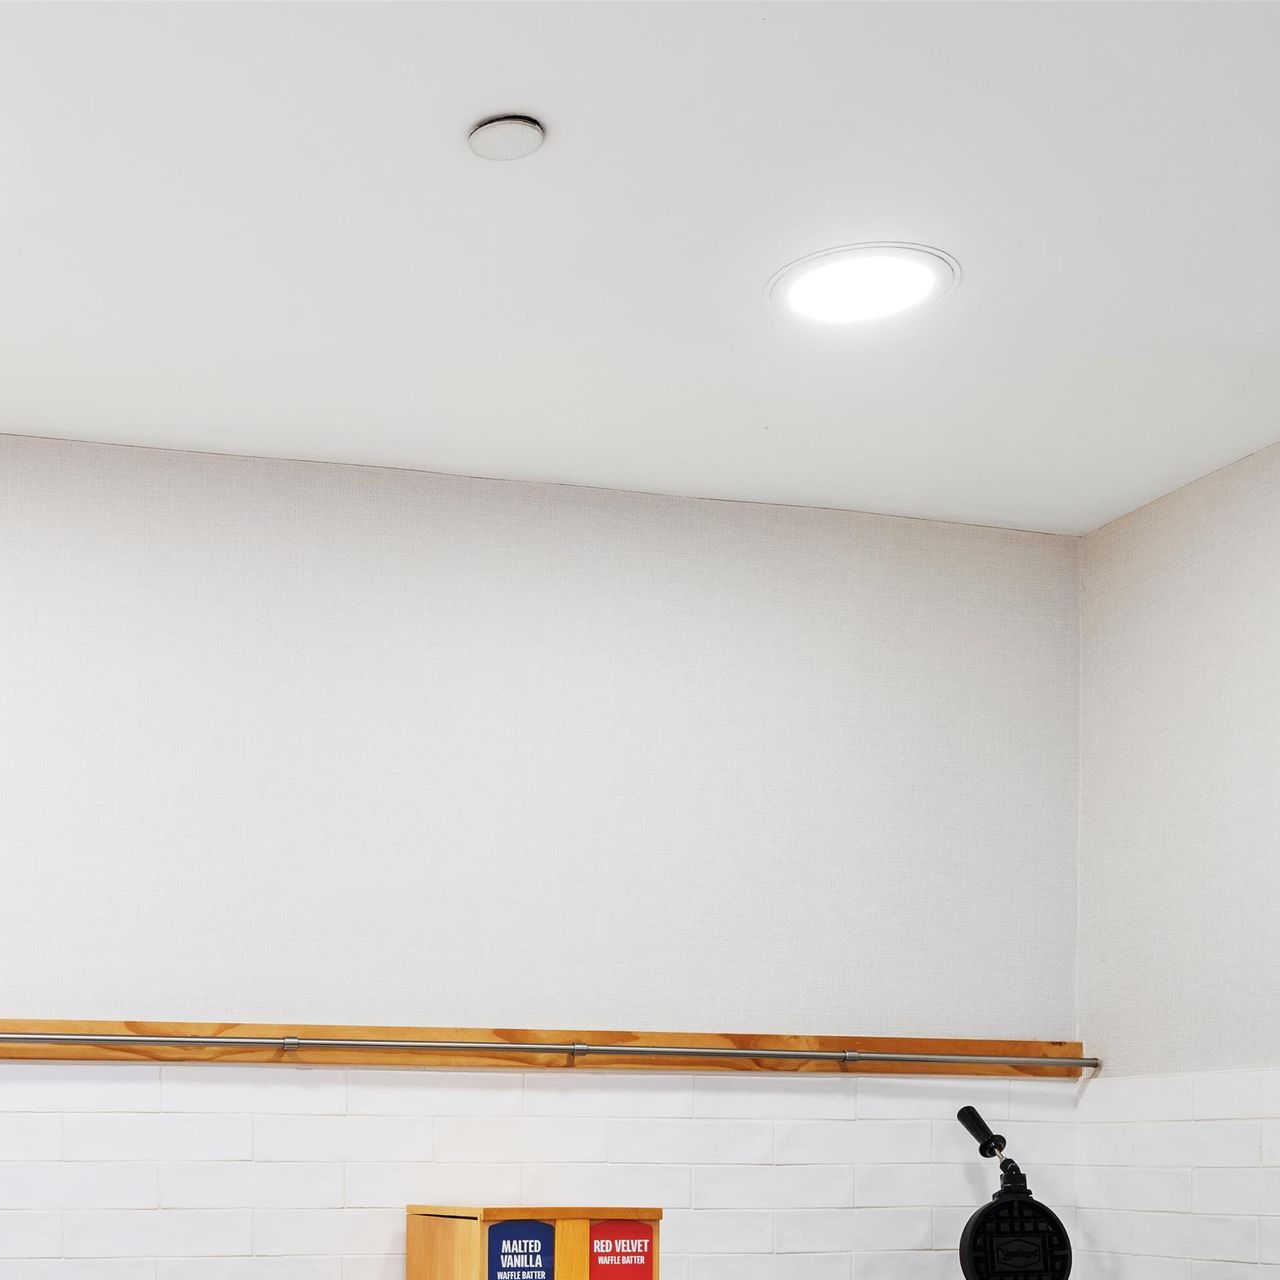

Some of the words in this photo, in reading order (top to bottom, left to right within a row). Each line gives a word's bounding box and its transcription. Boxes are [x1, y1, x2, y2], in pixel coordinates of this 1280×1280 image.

[501, 1240, 542, 1253] MALTED
[593, 1240, 612, 1253] RED
[614, 1240, 650, 1253] VELVET
[500, 1254, 543, 1268] VANILLA
[597, 1256, 621, 1265] WAFFLE
[621, 1256, 645, 1265] BATTER
[497, 1271, 521, 1280] WAFFLE
[521, 1271, 546, 1280] BATTER
